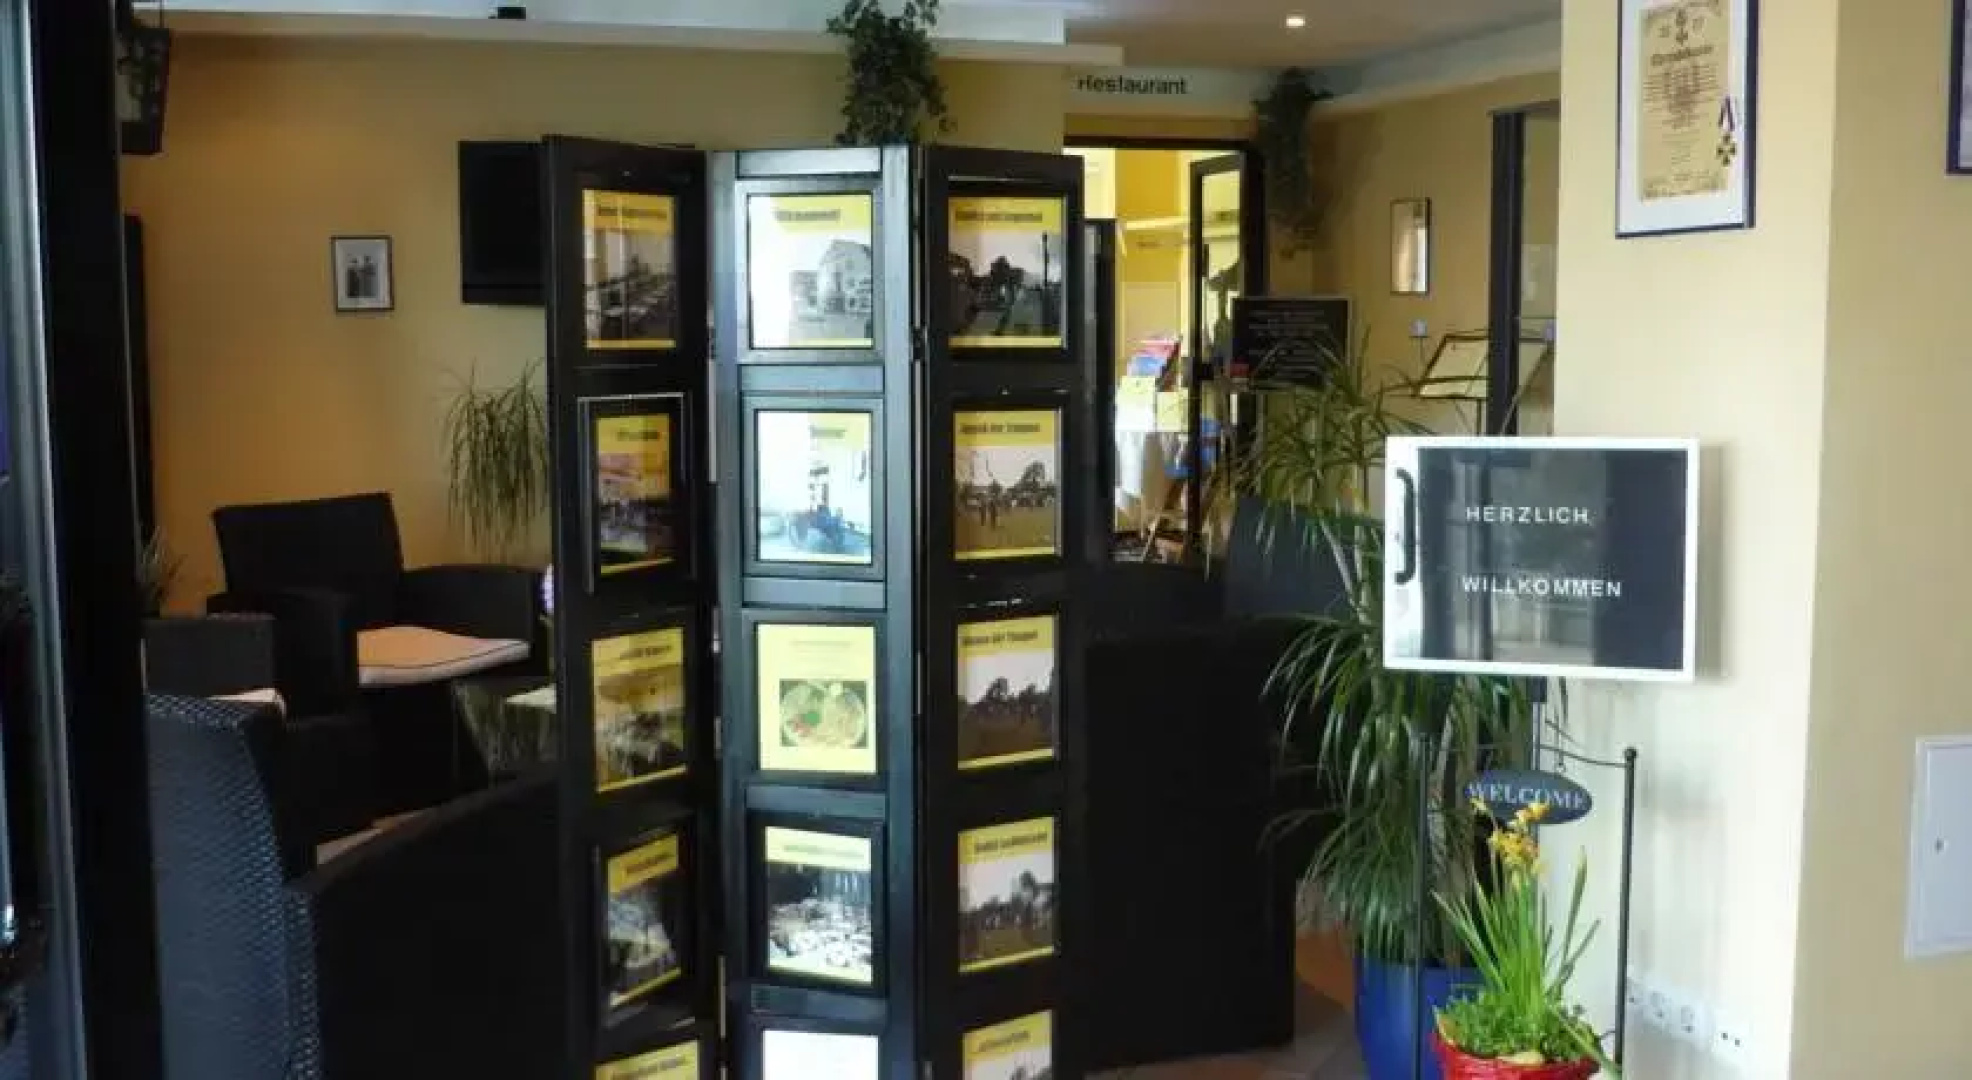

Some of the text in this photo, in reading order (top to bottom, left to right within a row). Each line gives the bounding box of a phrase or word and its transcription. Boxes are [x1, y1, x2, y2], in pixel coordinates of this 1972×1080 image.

[1466, 506, 1589, 525] HERZLICH
[1461, 575, 1622, 597] WILLKOMMEN
[1468, 782, 1584, 809] WELCOME
